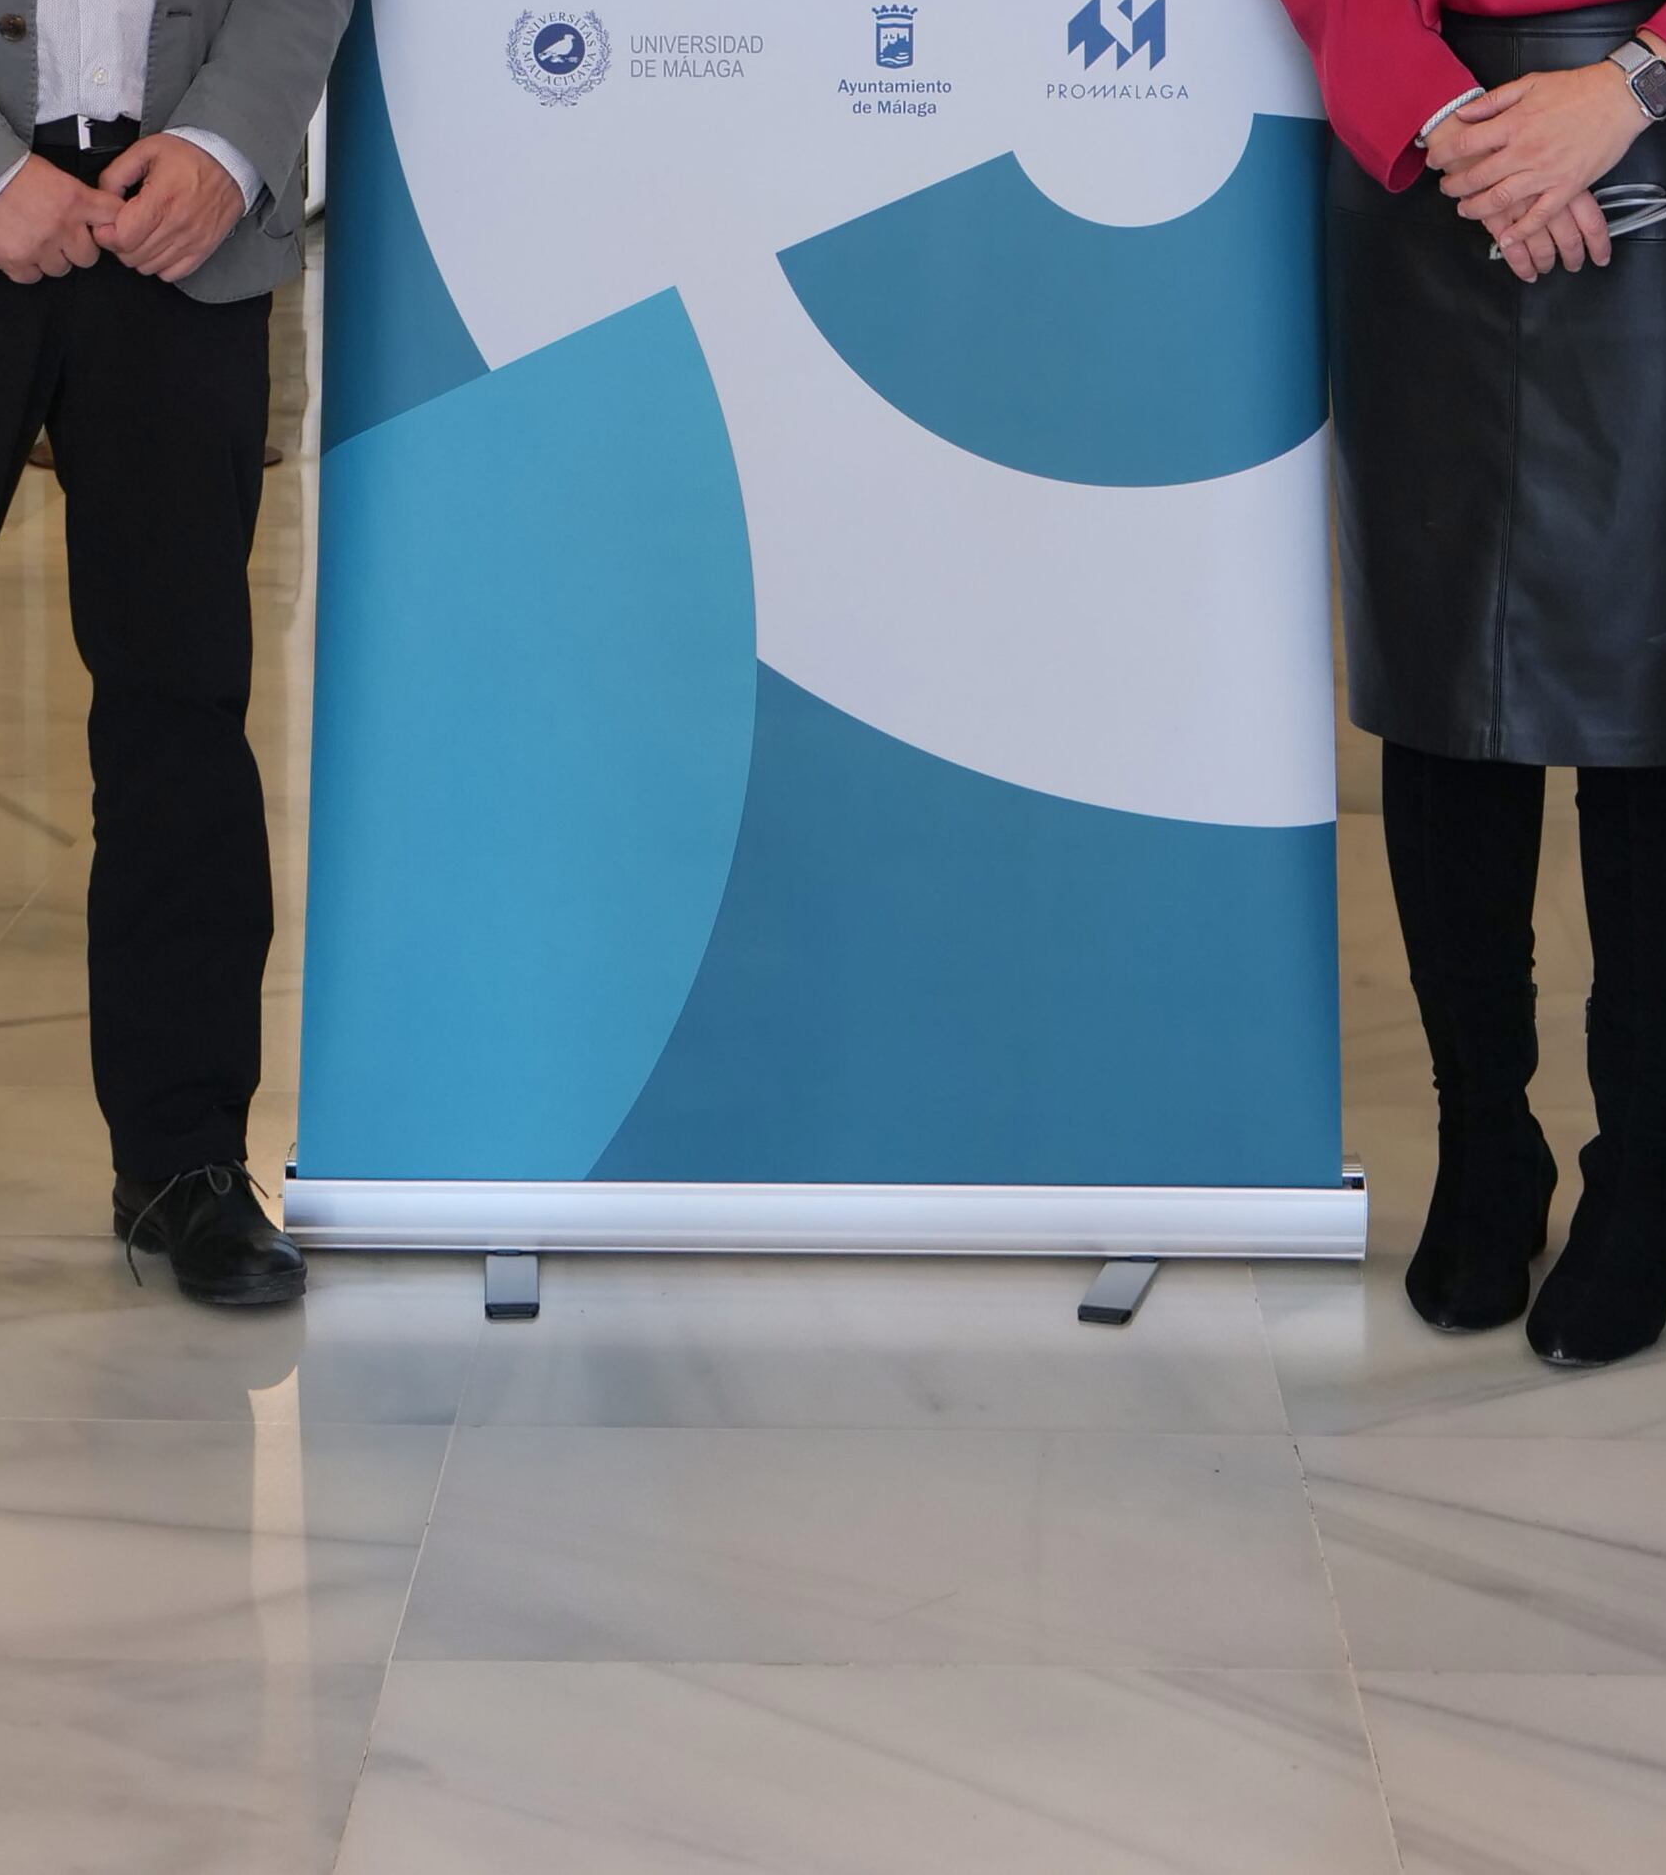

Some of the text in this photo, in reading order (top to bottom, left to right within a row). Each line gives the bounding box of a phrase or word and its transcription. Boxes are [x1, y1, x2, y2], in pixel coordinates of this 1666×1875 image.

[522, 11, 597, 47] UNIVERSITAS
[630, 35, 764, 54] UNIVERSIDAD
[630, 55, 745, 78] DE MÁLAGA
[837, 79, 952, 96] Ayuntamiento
[852, 99, 937, 117] de Málaga
